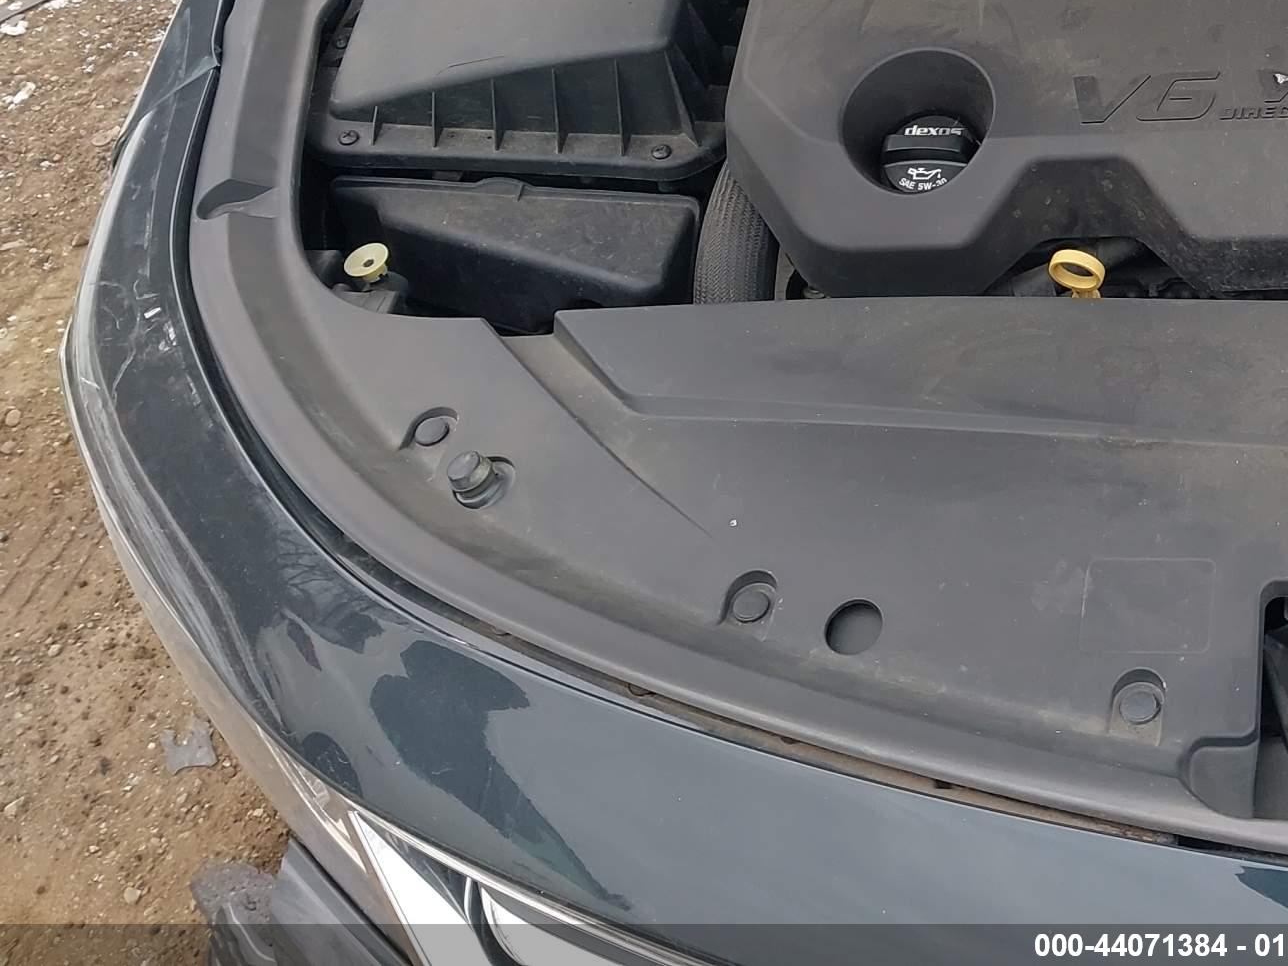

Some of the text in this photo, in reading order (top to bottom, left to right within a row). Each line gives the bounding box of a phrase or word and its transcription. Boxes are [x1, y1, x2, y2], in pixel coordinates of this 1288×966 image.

[1073, 71, 1221, 124] V6
[904, 125, 965, 136] dexos
[898, 177, 916, 190] SAE
